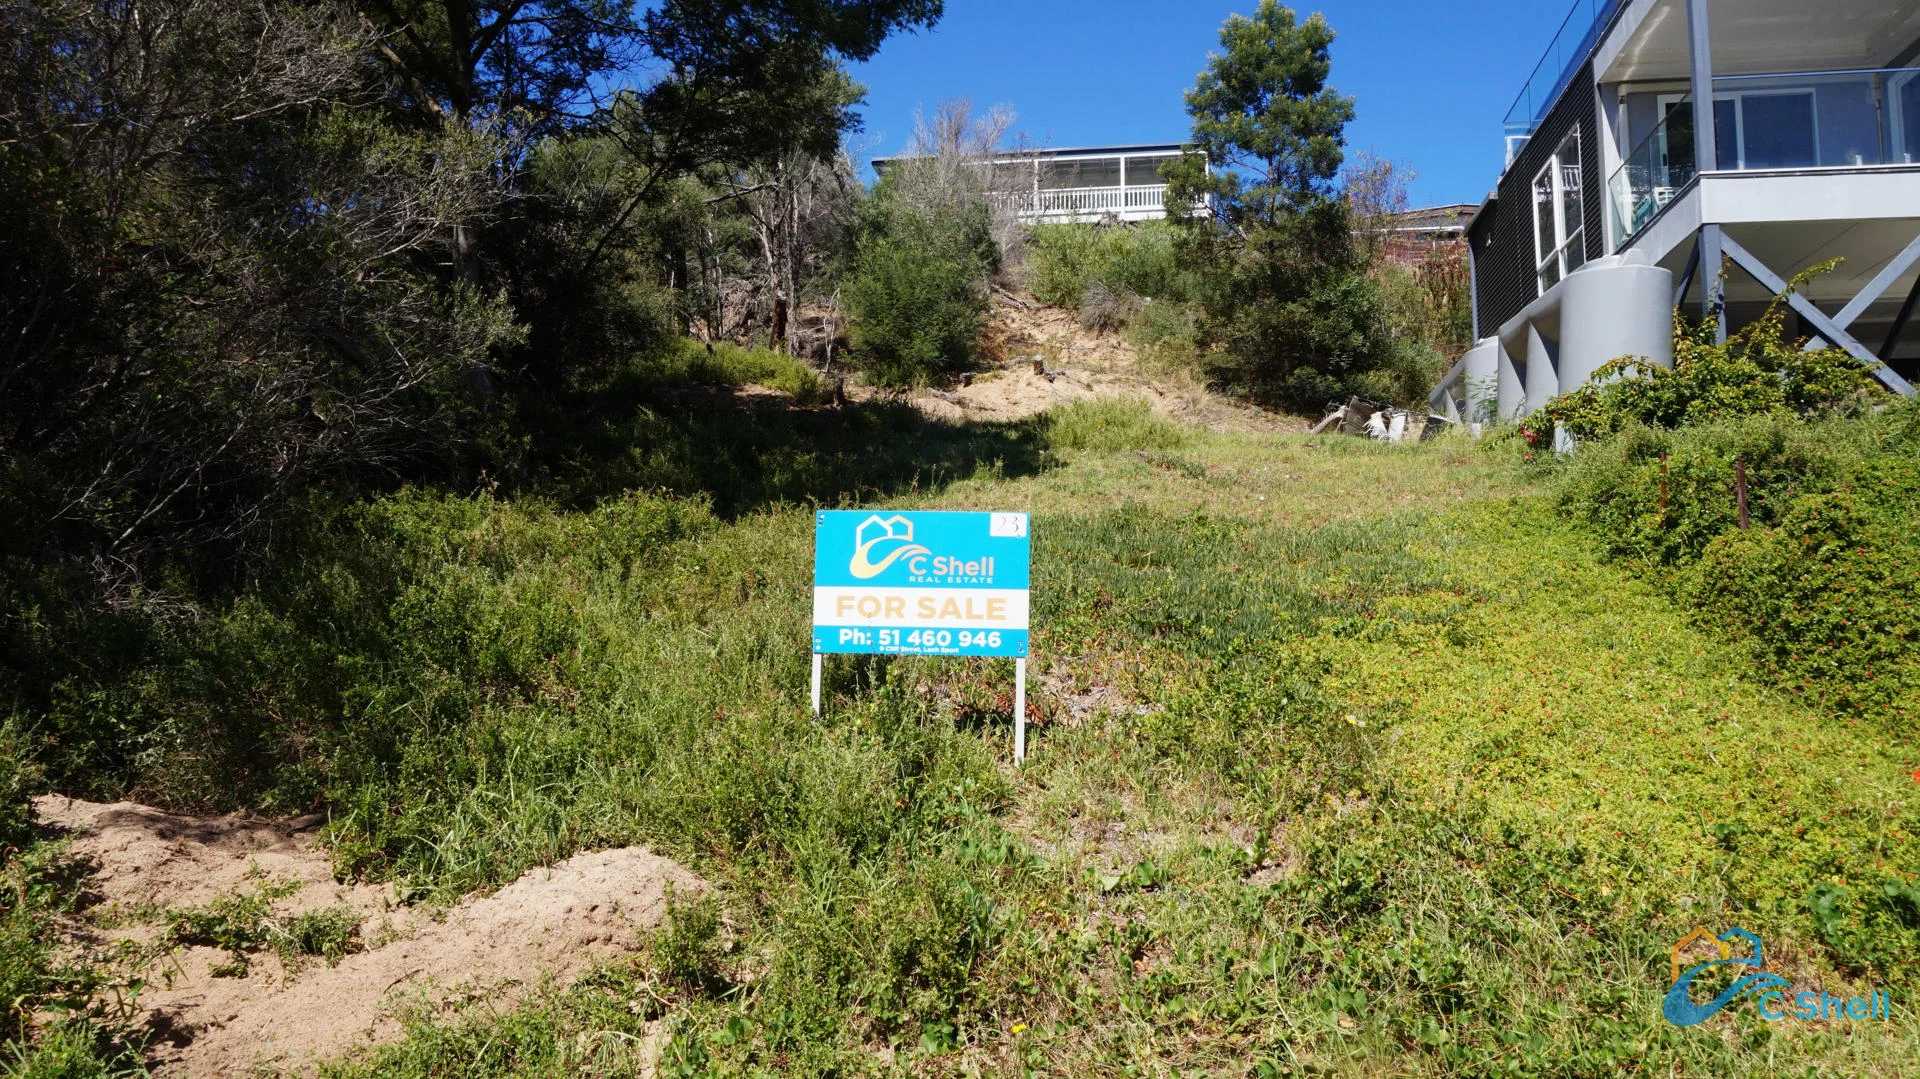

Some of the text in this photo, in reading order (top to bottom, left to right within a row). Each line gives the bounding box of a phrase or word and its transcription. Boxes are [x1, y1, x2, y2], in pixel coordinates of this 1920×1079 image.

[909, 556, 994, 577] C Shell
[837, 596, 1007, 621] FOR SALE
[839, 628, 1002, 648] Ph: 51 460 946
